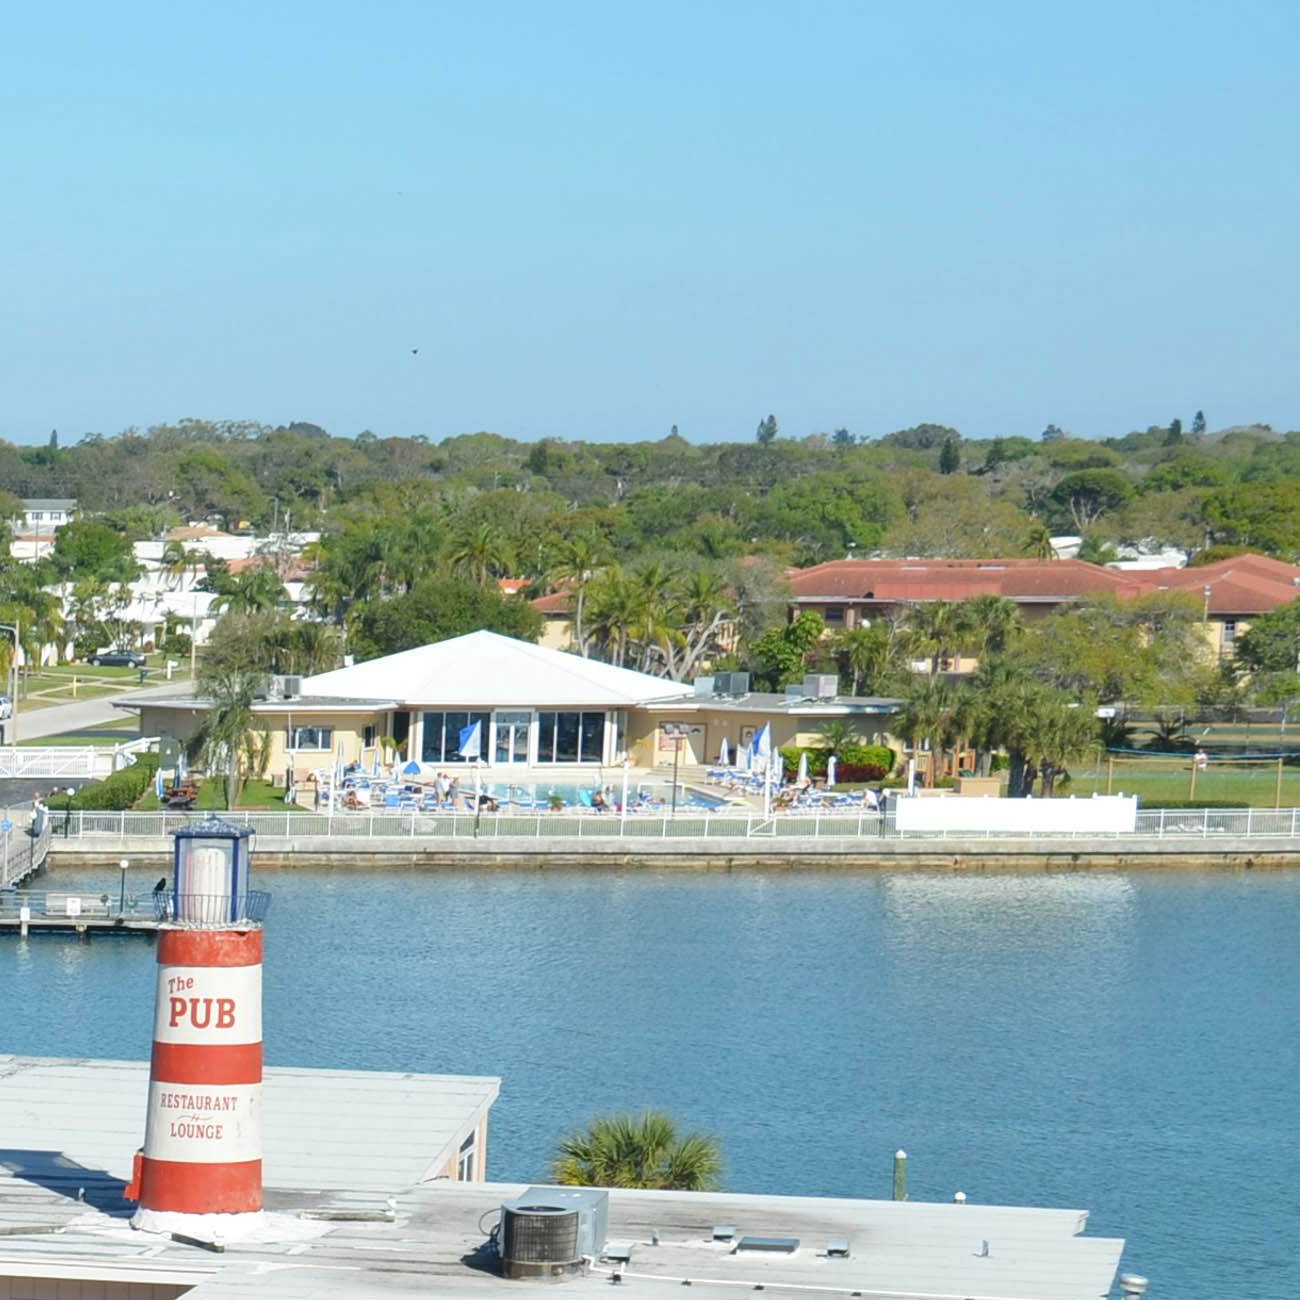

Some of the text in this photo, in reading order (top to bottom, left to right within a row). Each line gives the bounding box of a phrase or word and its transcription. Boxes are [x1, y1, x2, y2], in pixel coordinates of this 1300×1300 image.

[168, 976, 194, 993] The
[169, 997, 236, 1029] PUB
[160, 1093, 238, 1111] RESTAURANT
[170, 1122, 223, 1140] LOUNGE
